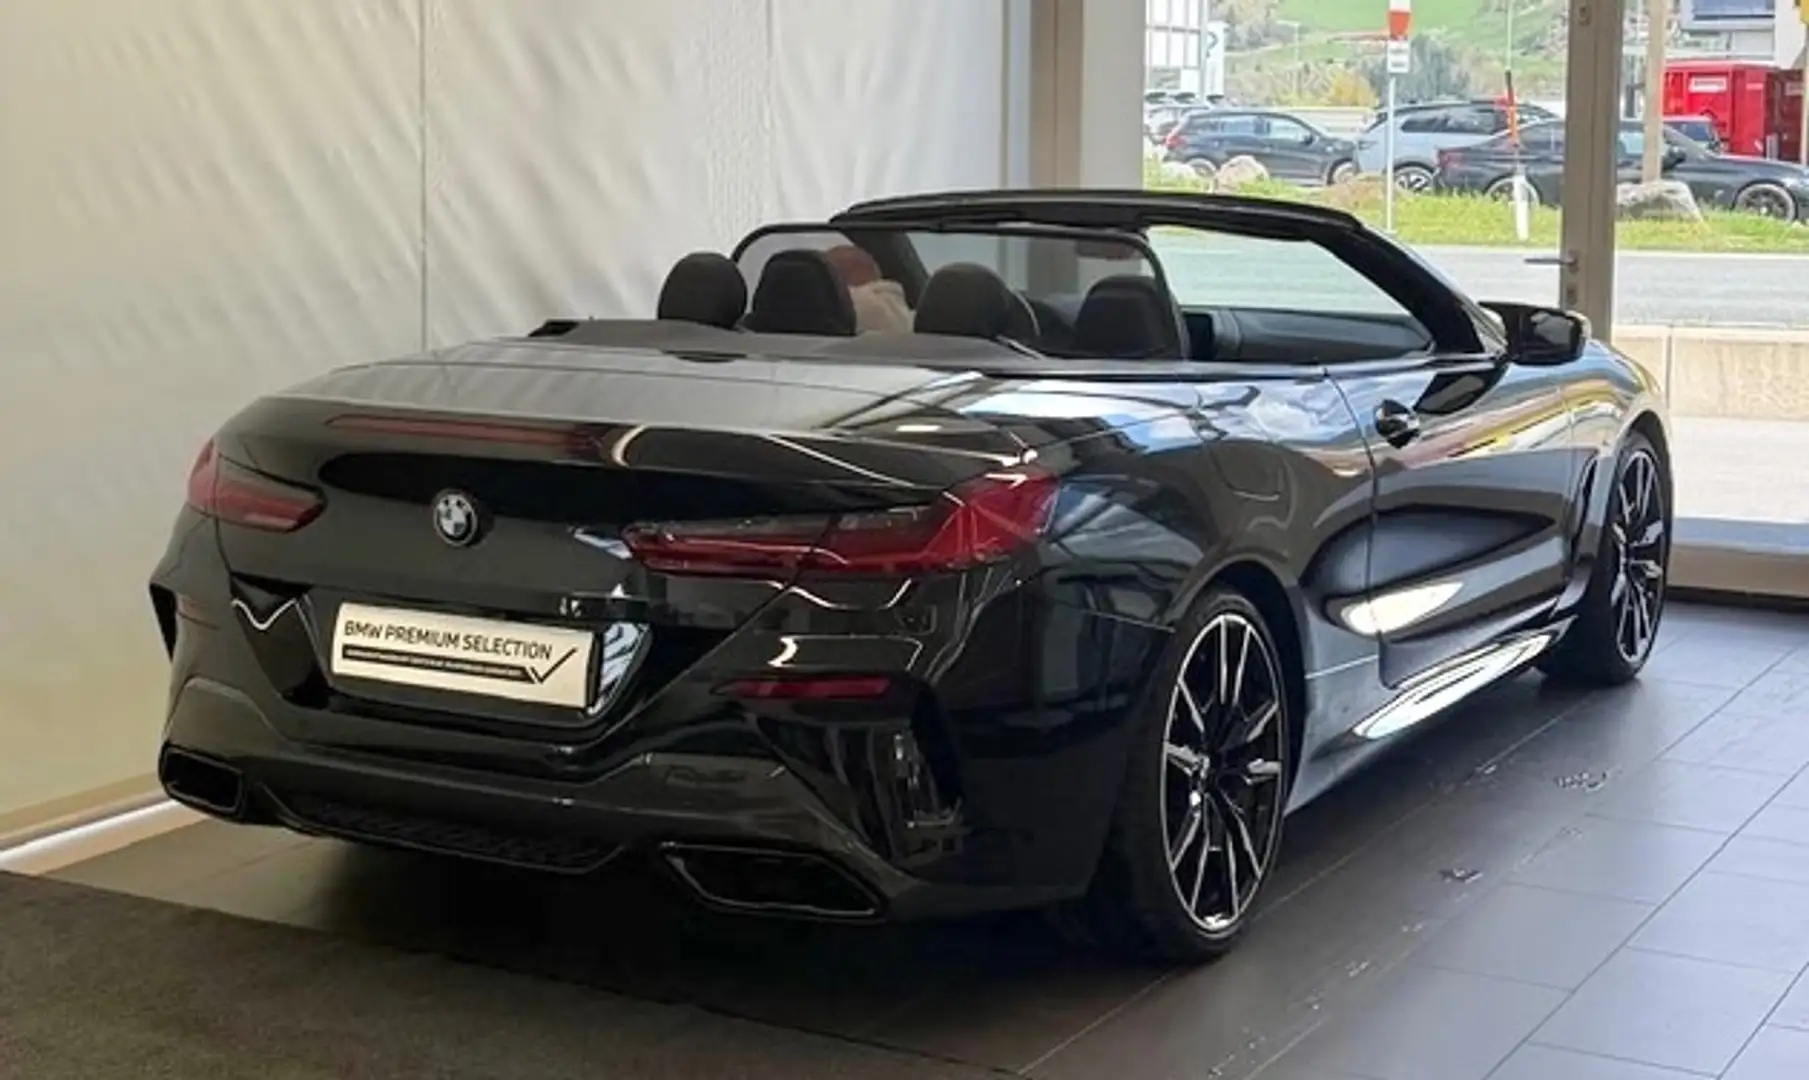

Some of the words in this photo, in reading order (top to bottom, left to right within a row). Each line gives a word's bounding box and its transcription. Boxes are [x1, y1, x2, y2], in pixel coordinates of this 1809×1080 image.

[344, 619, 383, 639] BMW
[385, 624, 460, 649] PREMIUM
[462, 635, 553, 660] SELECTION
